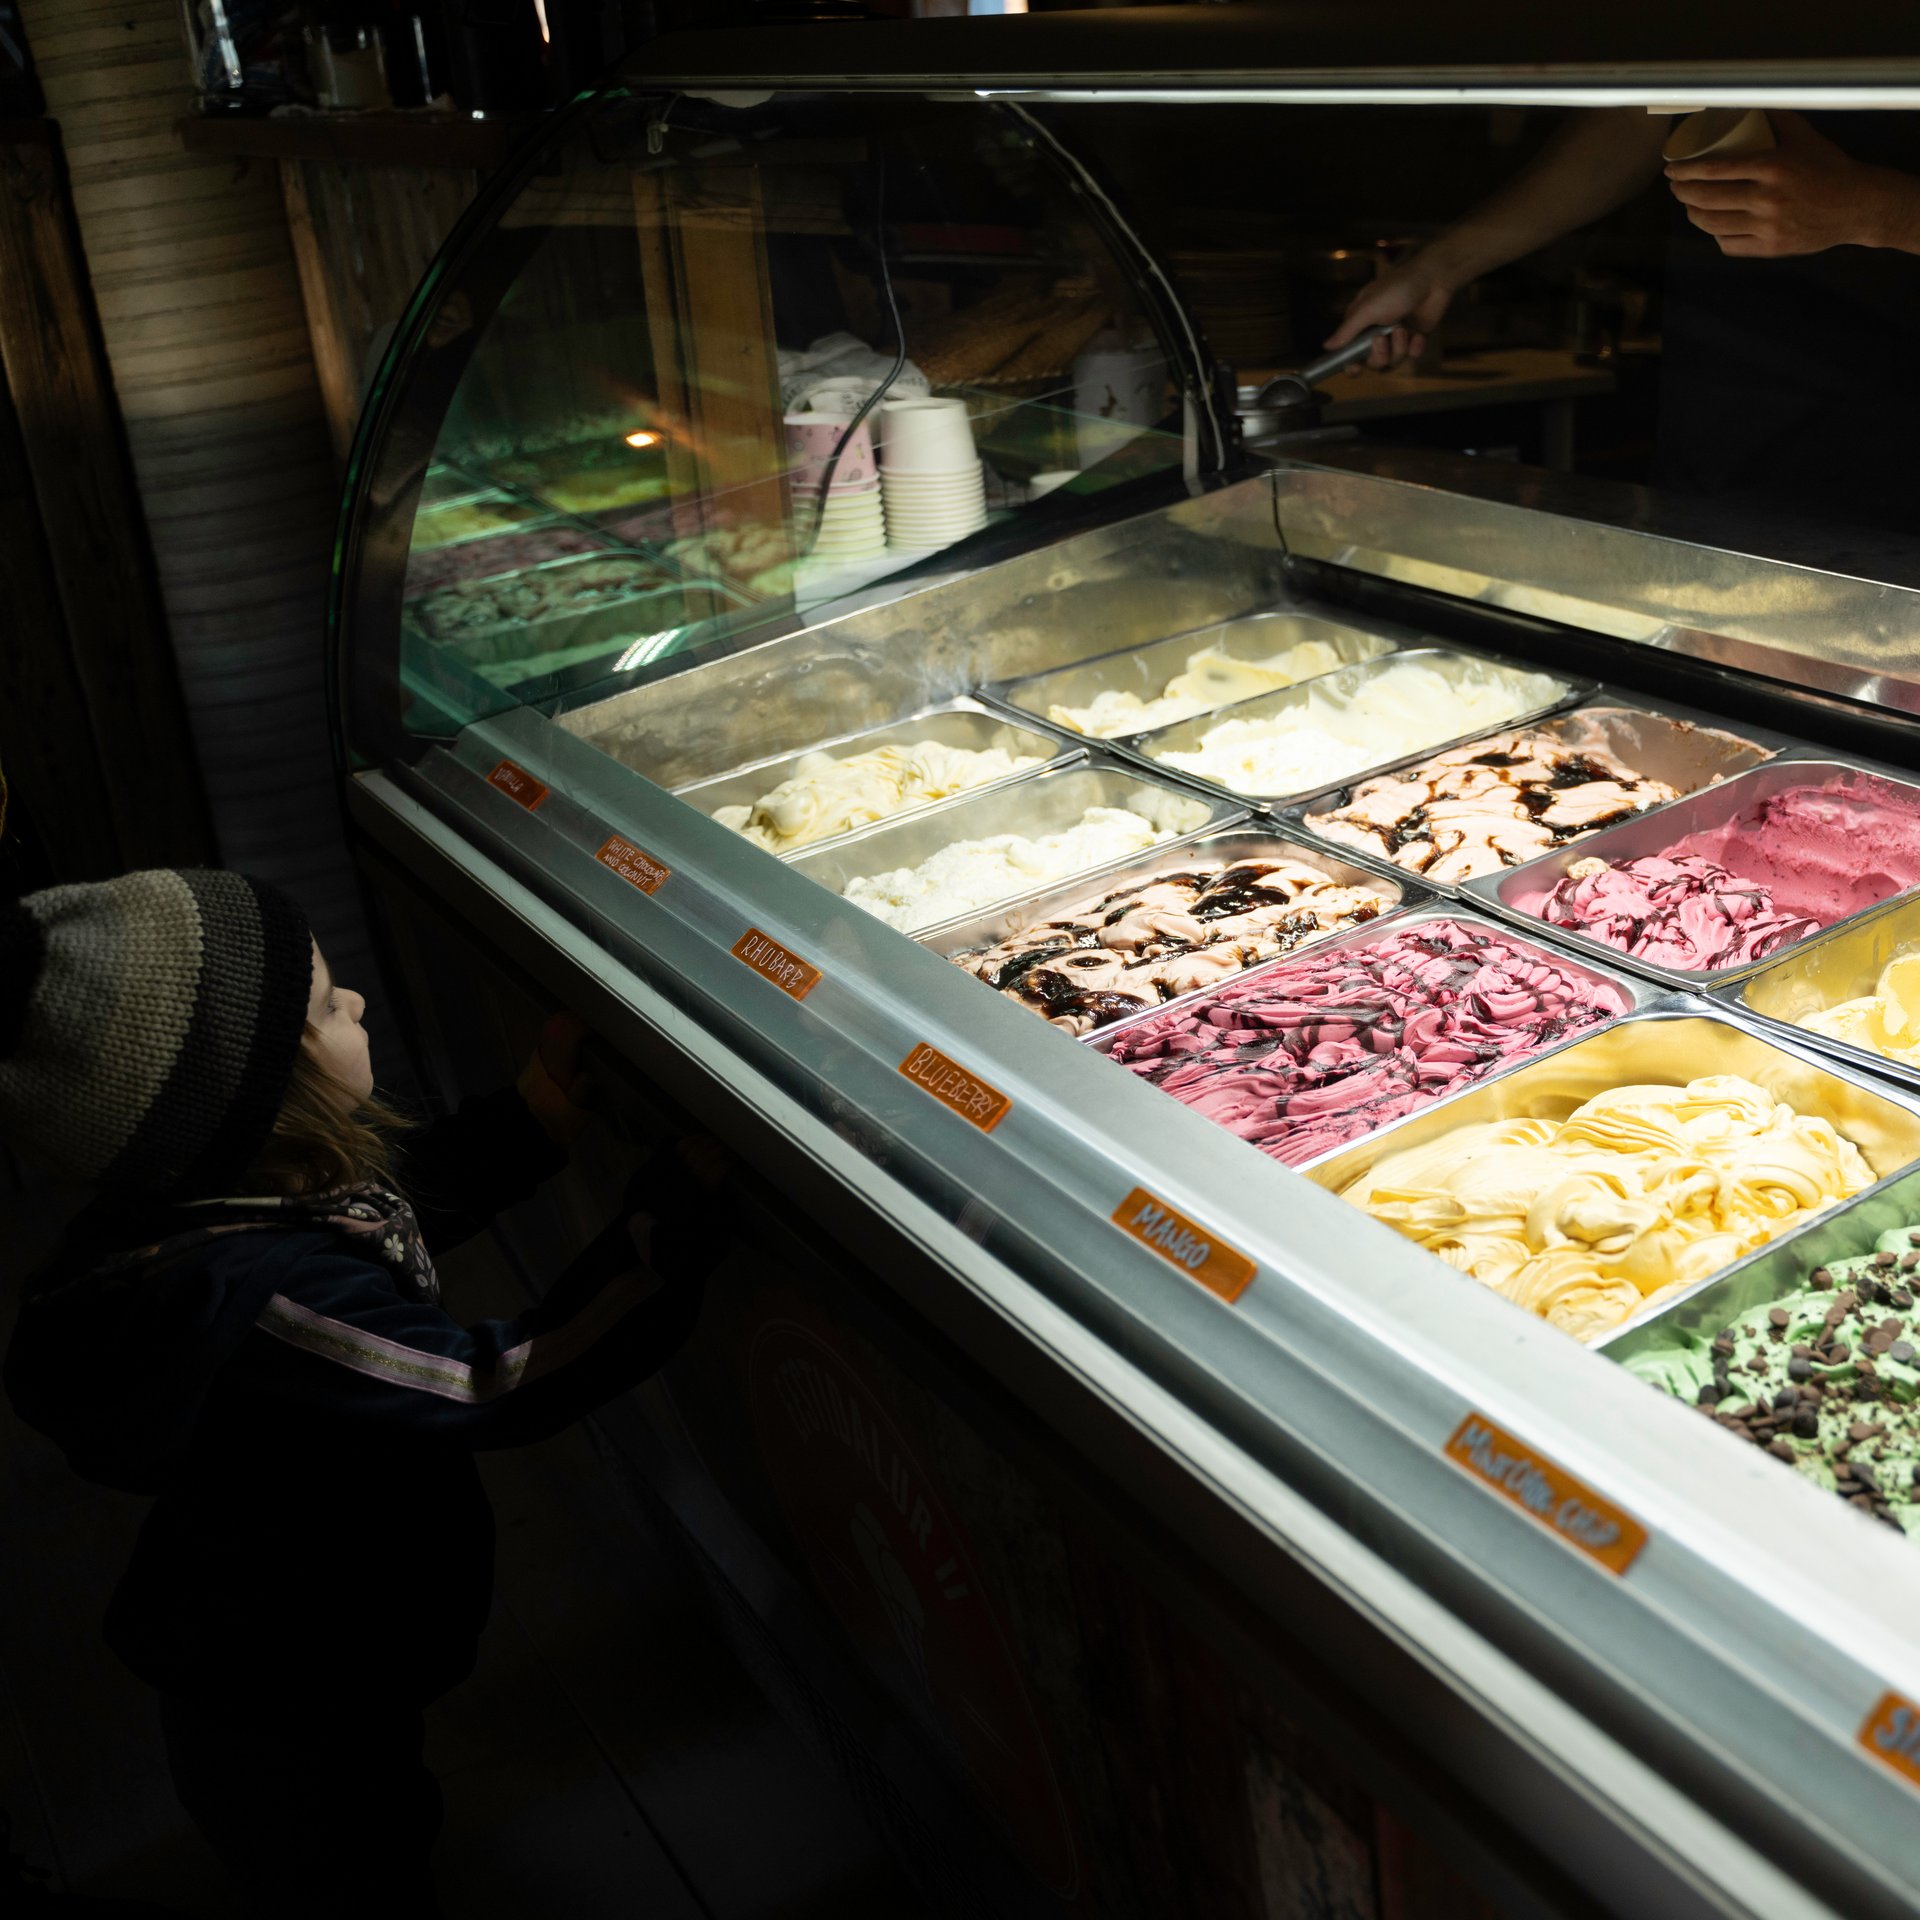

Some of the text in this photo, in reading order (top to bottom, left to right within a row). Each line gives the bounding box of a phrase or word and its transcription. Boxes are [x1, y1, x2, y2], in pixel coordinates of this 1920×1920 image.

[604, 854, 652, 887] AND COCONUT
[608, 839, 635, 861] WHITE
[741, 935, 804, 989] RHUBARB
[908, 1047, 1000, 1120] BLUEBERRY
[1131, 1203, 1210, 1269] MANGO
